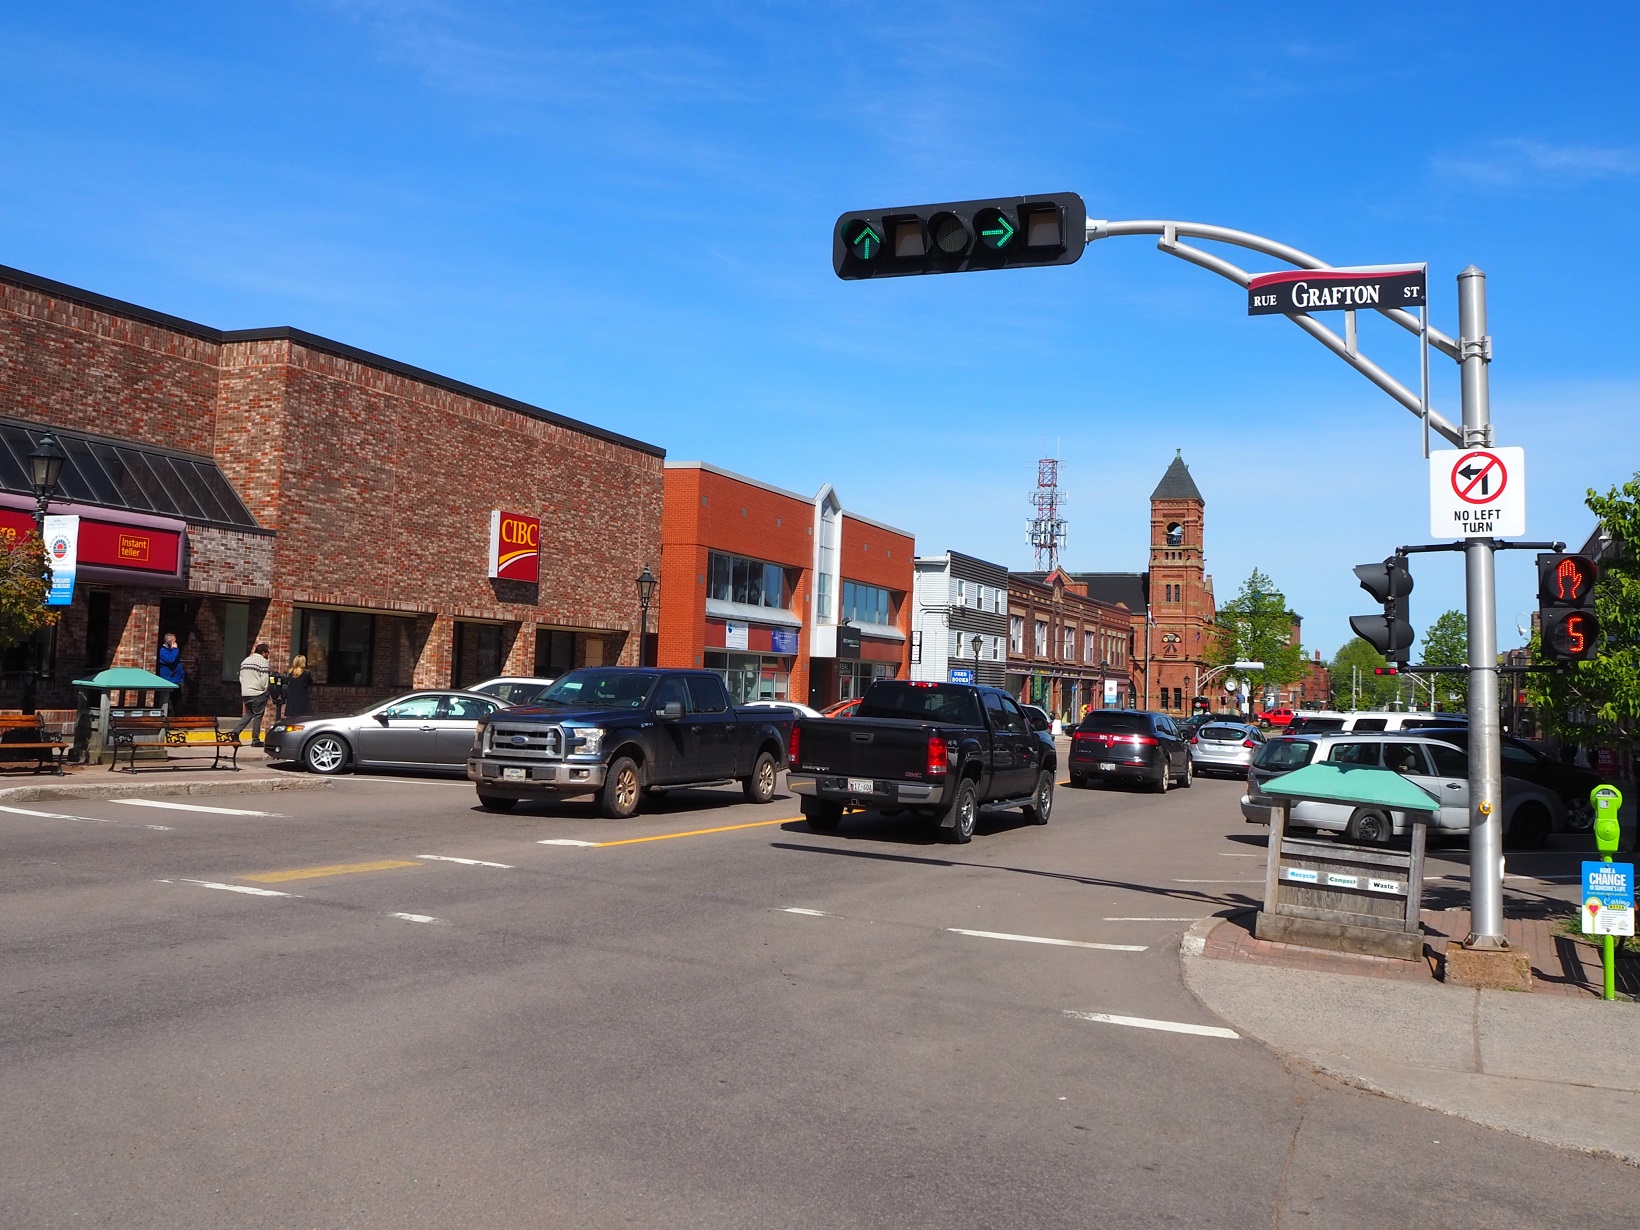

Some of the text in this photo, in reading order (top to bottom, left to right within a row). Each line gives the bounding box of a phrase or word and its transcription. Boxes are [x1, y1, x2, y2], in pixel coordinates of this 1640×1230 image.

[1253, 281, 1420, 308] RUE GRAFTON ST
[1453, 509, 1502, 521] NO LEFT
[0, 527, 16, 541] re
[502, 519, 538, 547] CIBC
[1462, 522, 1493, 533] TURN
[121, 538, 147, 549] Instant
[121, 547, 140, 557] teller
[1568, 617, 1584, 652] 5
[1290, 871, 1394, 890] Recycle Compost Waste
[1589, 873, 1627, 887] CHANGE
